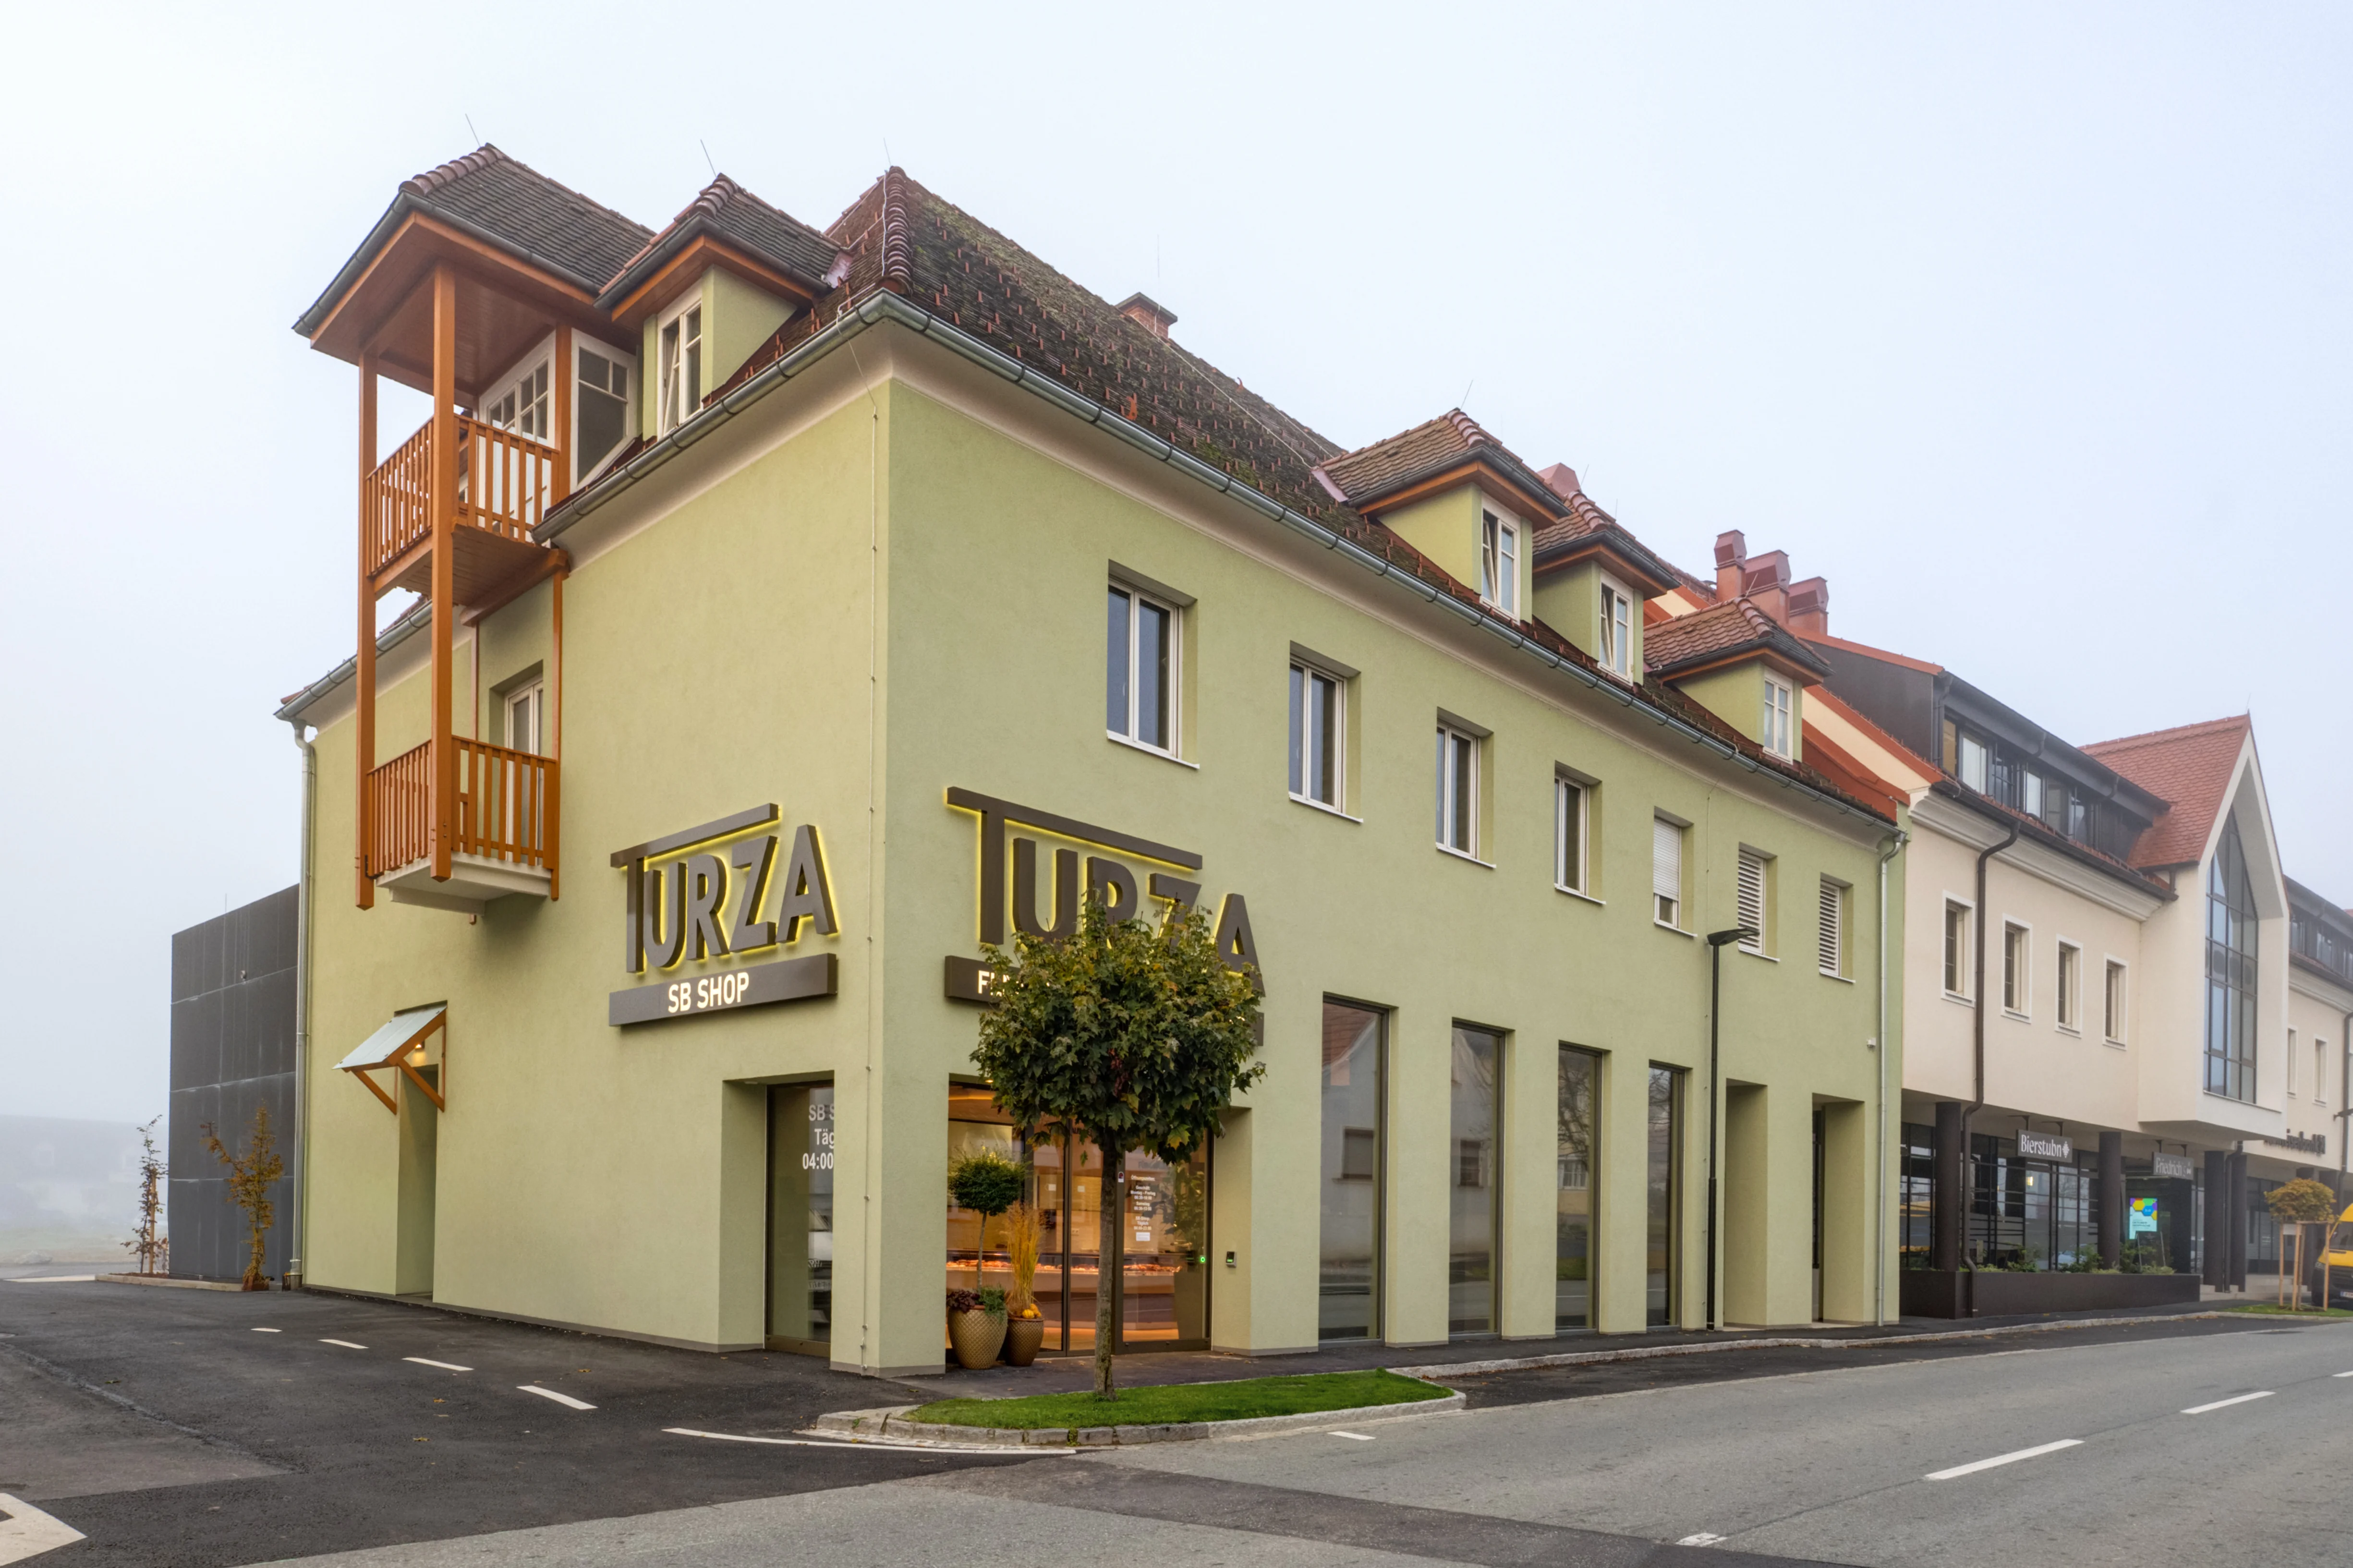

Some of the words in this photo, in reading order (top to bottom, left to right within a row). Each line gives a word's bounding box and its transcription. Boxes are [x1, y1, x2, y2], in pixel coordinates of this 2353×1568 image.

[610, 803, 838, 973] TURZA
[668, 982, 691, 1013] SB
[697, 972, 750, 1008] SHOP
[809, 1104, 825, 1121] SB
[2021, 1134, 2062, 1158] Bierstubn
[802, 1152, 834, 1170] 04:00
